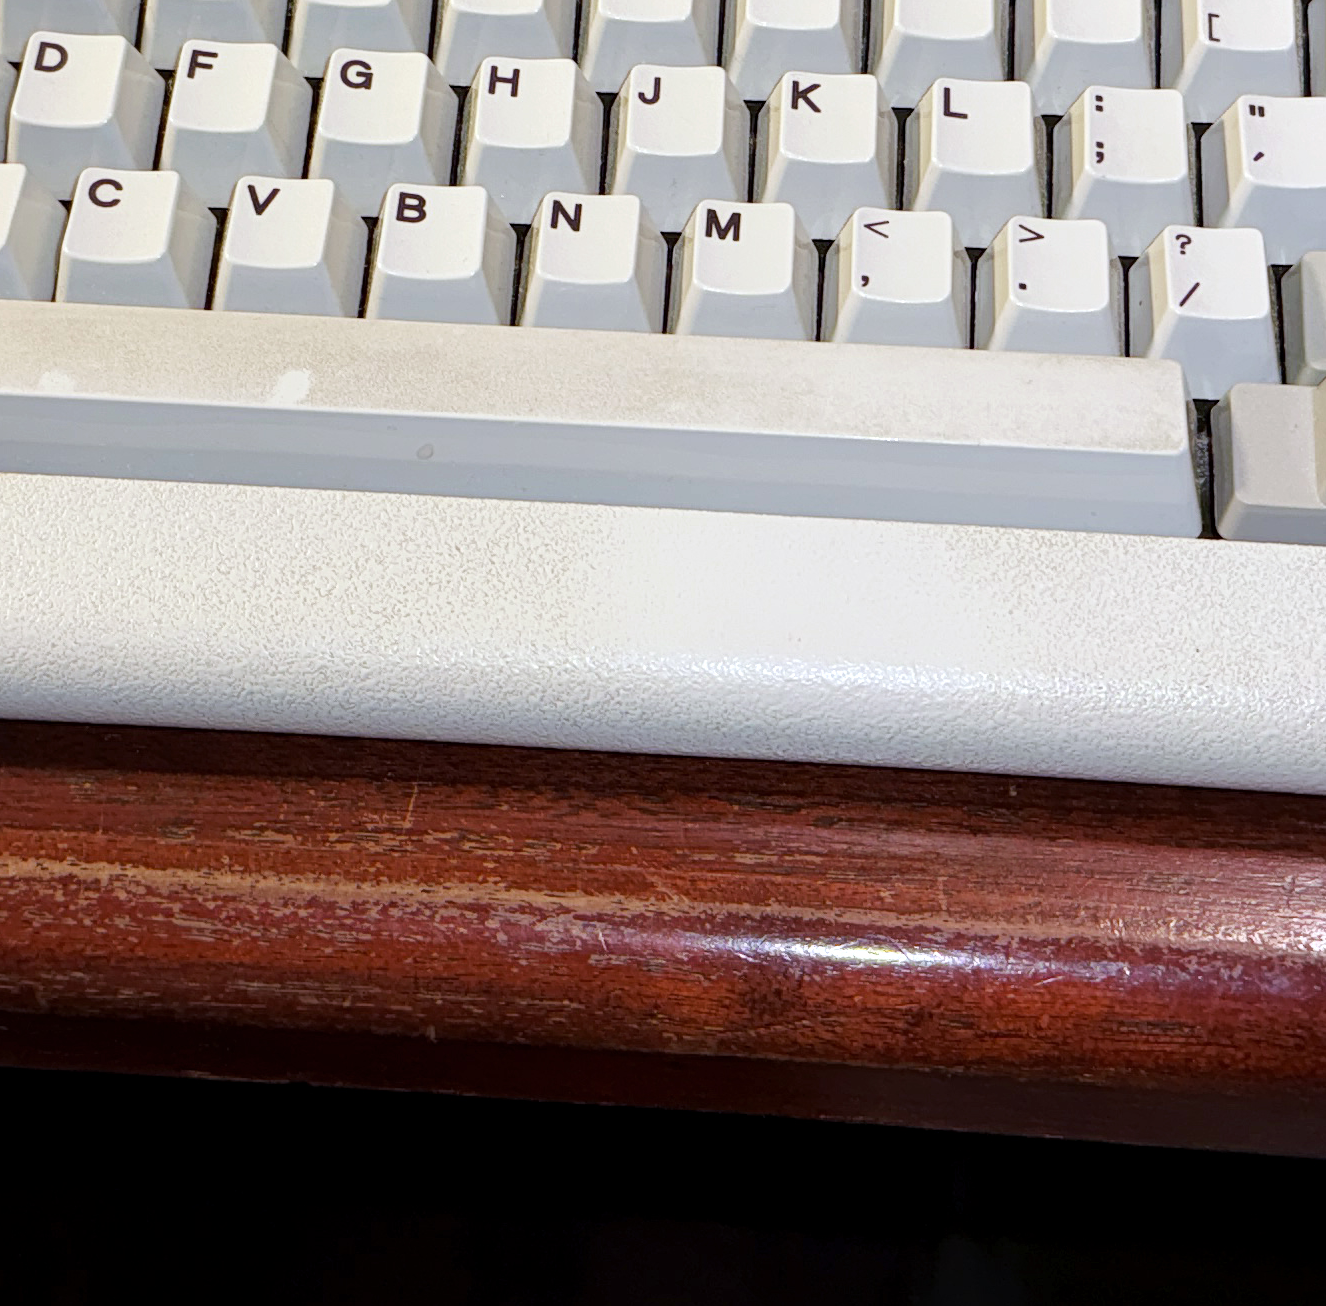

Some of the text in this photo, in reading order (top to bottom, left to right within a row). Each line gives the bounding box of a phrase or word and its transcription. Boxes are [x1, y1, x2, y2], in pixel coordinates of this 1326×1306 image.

[34, 41, 68, 73] D
[187, 49, 218, 79] F
[340, 60, 373, 90] G
[488, 65, 520, 97] H
[638, 77, 661, 105] J
[791, 80, 821, 113] K
[943, 87, 968, 119] L
[88, 178, 123, 208] C
[247, 184, 281, 216] V
[396, 192, 427, 223] B
[550, 200, 582, 232] N
[705, 208, 741, 242] M
